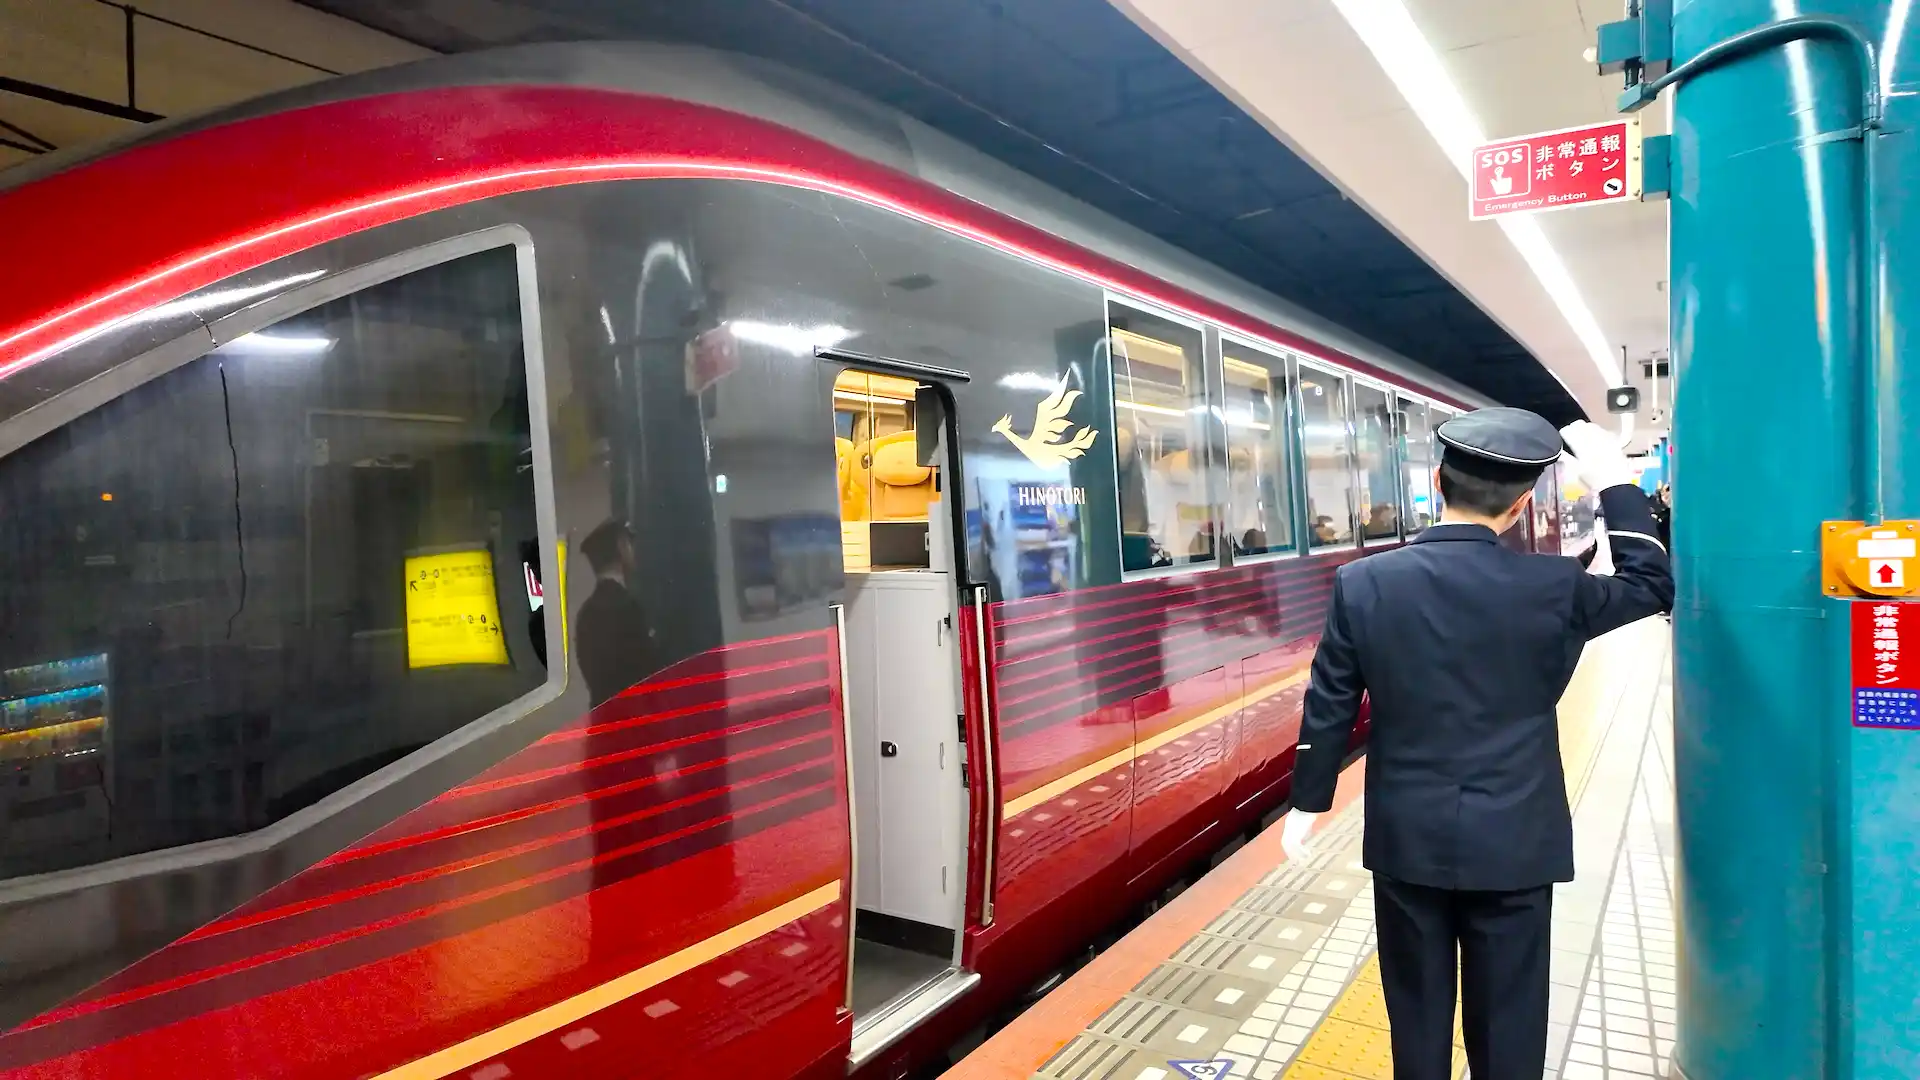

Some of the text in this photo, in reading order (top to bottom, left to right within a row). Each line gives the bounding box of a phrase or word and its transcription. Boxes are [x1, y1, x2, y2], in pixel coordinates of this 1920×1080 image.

[1481, 148, 1523, 168] SOS
[1536, 134, 1621, 163] 非常通報
[1536, 157, 1619, 181] ボタン
[1485, 191, 1587, 212] Emergency Button
[1019, 487, 1086, 505] HINOTORI
[1873, 605, 1900, 685] 非常通報ボタン
